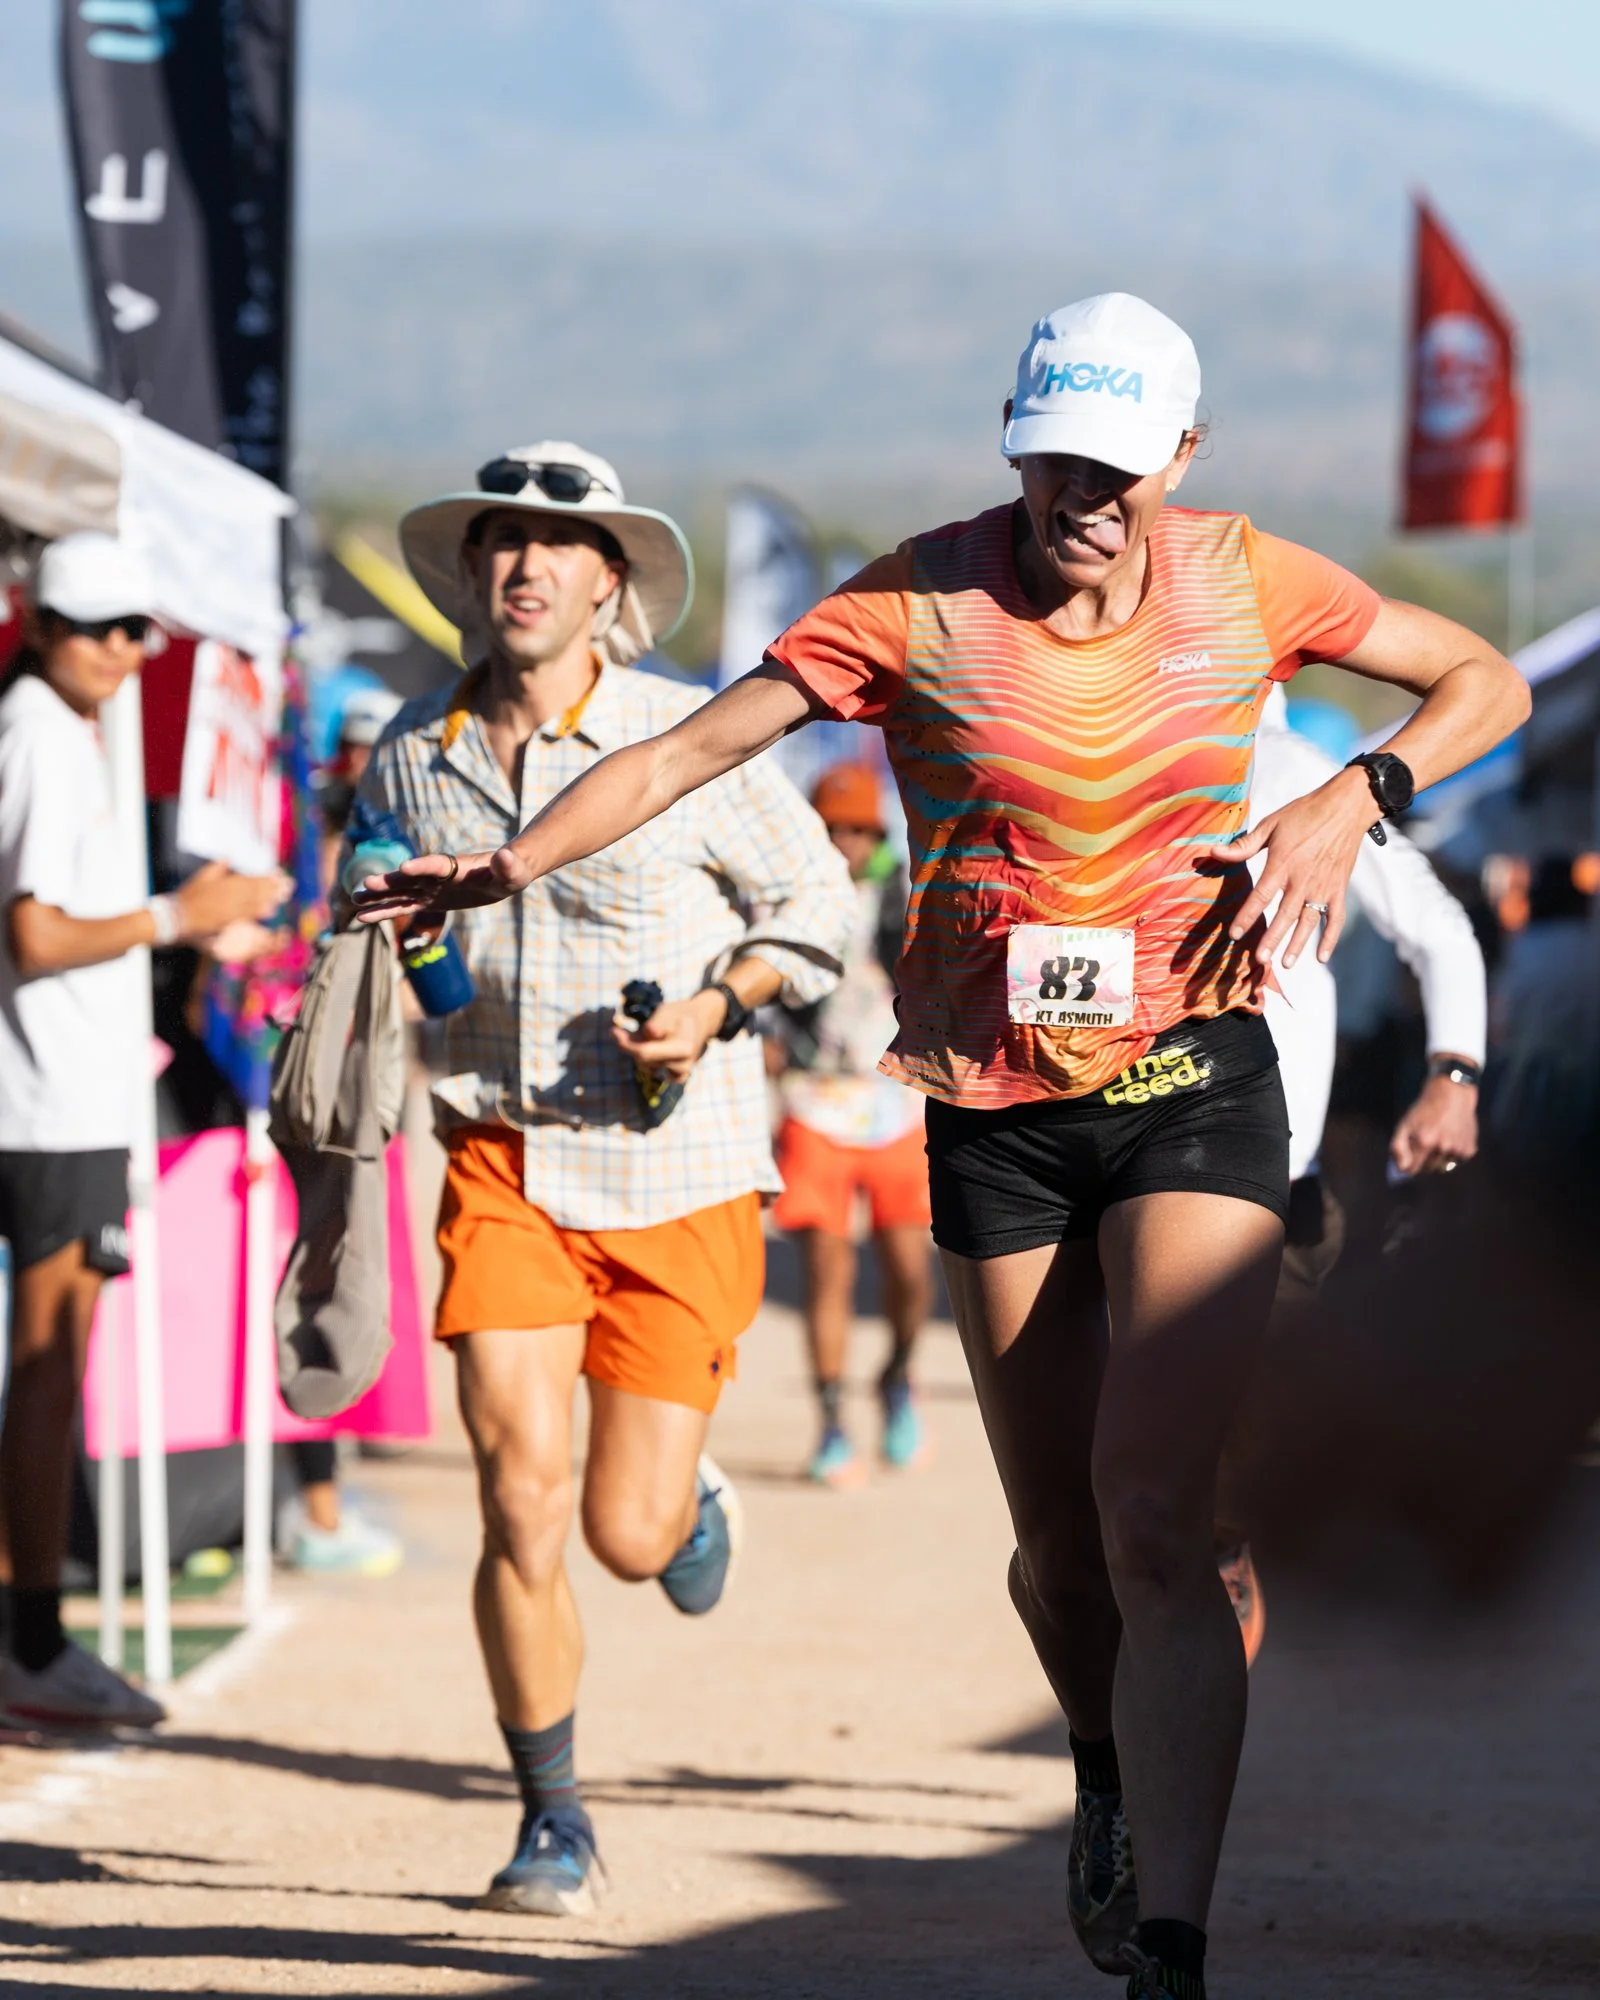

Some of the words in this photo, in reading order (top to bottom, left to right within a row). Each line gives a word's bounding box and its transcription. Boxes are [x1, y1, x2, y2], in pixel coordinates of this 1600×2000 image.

[1043, 362, 1143, 404] HOKA
[1158, 652, 1212, 674] HOKA
[1038, 956, 1100, 1002] 83
[1058, 1010, 1113, 1025] ASMUTH
